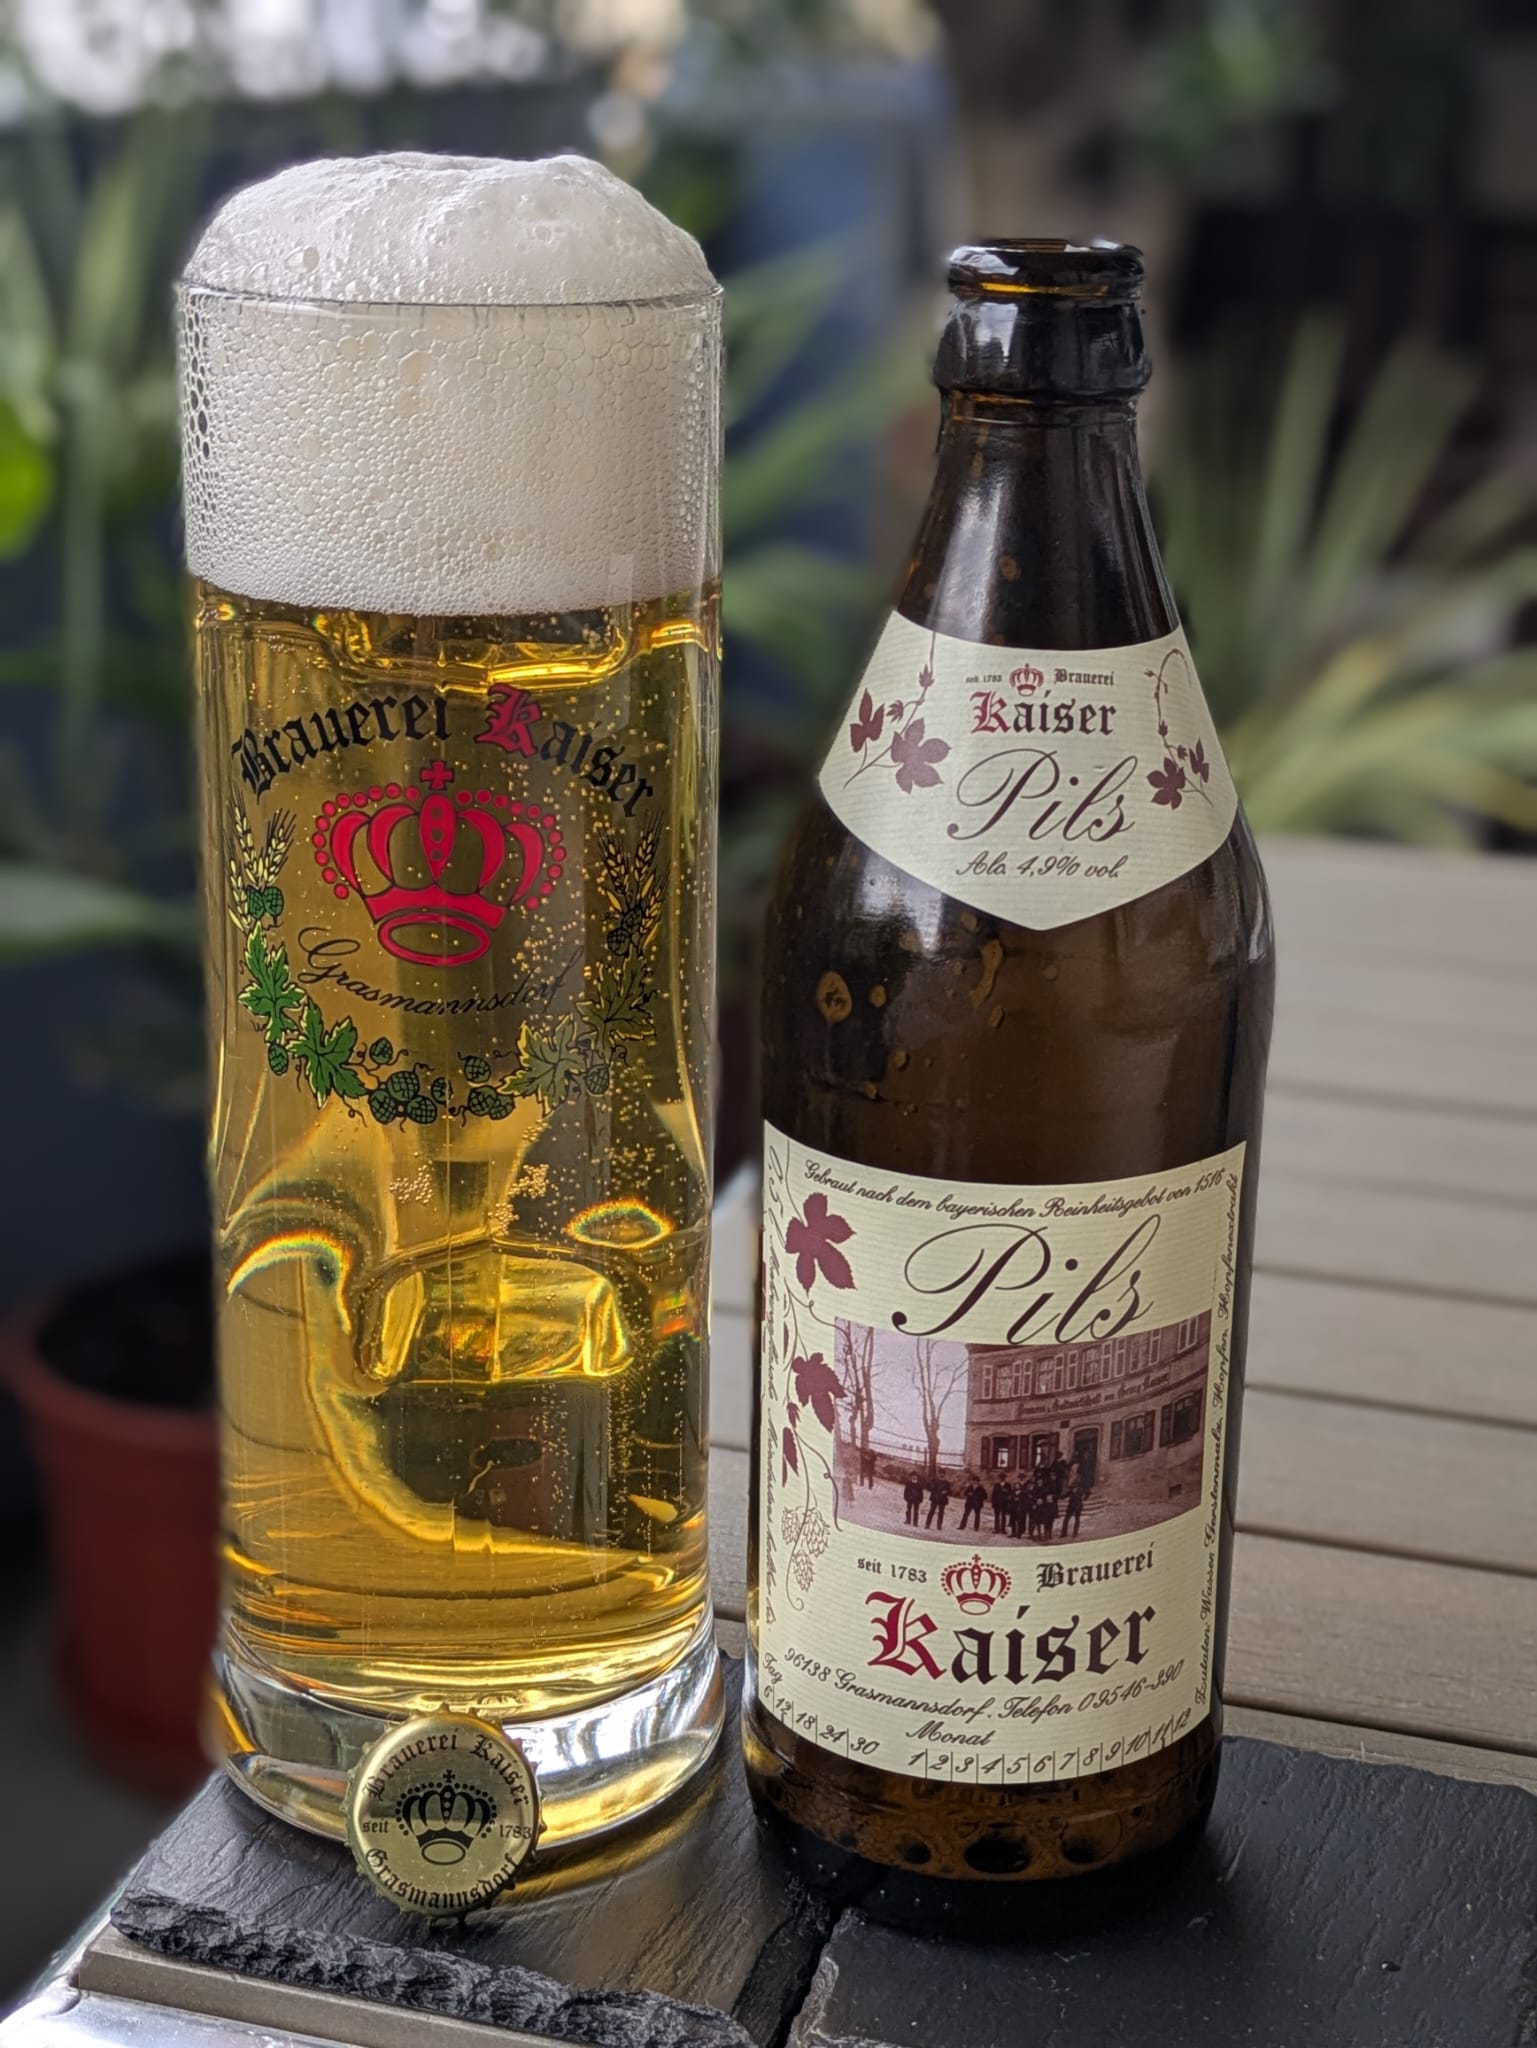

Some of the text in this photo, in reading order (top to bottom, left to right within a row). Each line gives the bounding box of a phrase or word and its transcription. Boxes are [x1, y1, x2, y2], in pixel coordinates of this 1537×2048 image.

[1054, 668, 1115, 686] Brauerei
[969, 690, 1117, 736] Kaiser
[230, 683, 654, 818] Brauerei Kaiser
[947, 748, 1138, 842] Pils
[1016, 855, 1081, 878] 4,9%
[297, 927, 585, 1015] Grasmannsdorf
[803, 1159, 1226, 1220] Gebraut nach dem bayerischen Reinheitsgebot von 1516
[891, 1213, 1162, 1346] Pils
[857, 1541, 1155, 1593] seit 1783 Brauerei
[762, 1652, 783, 1685] Tag
[865, 1591, 1156, 1685] Kaiser
[784, 1647, 832, 1682] 96138
[998, 1694, 1074, 1724] Telefon
[763, 1685, 880, 1755] 6 12 18 24 30
[905, 1720, 996, 1746] Monat
[908, 1751, 925, 1767] 1
[929, 1754, 949, 1771] 2
[955, 1756, 974, 1774] 3
[981, 1754, 1002, 1774] 4
[1006, 1757, 1026, 1775] 5
[1033, 1755, 1052, 1773] 6
[1059, 1752, 1074, 1772] 7
[1082, 1748, 1099, 1767] 8
[1105, 1741, 1121, 1762] 9
[1127, 1731, 1149, 1755] 10
[1174, 1708, 1192, 1732] 12
[363, 1728, 530, 1807] Brauerei Kaiser
[361, 1819, 532, 1841] seit 1783
[366, 1848, 519, 1909] Grasmannsdorf
